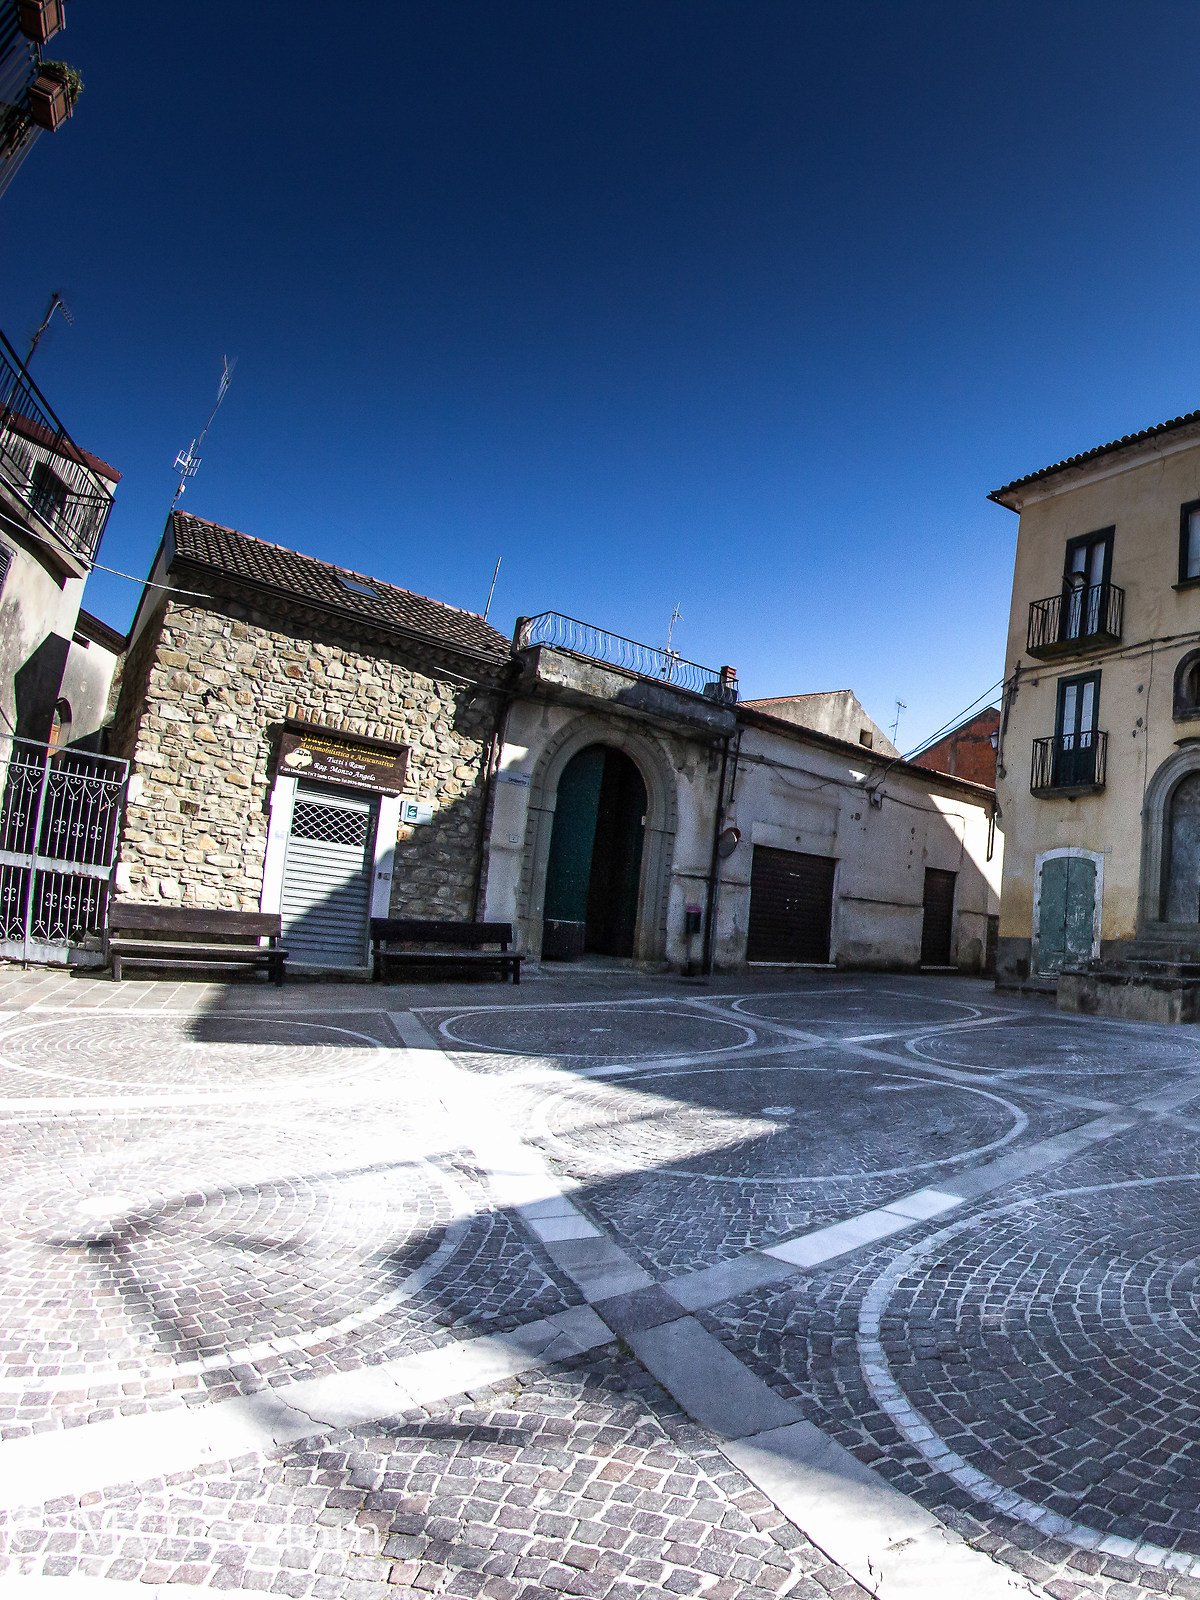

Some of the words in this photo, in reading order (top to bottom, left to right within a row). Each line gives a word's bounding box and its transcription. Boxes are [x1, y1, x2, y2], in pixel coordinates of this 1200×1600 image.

[298, 741, 349, 758] Automobilistica
[353, 754, 394, 768] Assicurativa
[326, 756, 344, 766] Tutti
[349, 761, 366, 770] Rami
[330, 765, 353, 776] Monzo
[352, 771, 376, 781] Angelo
